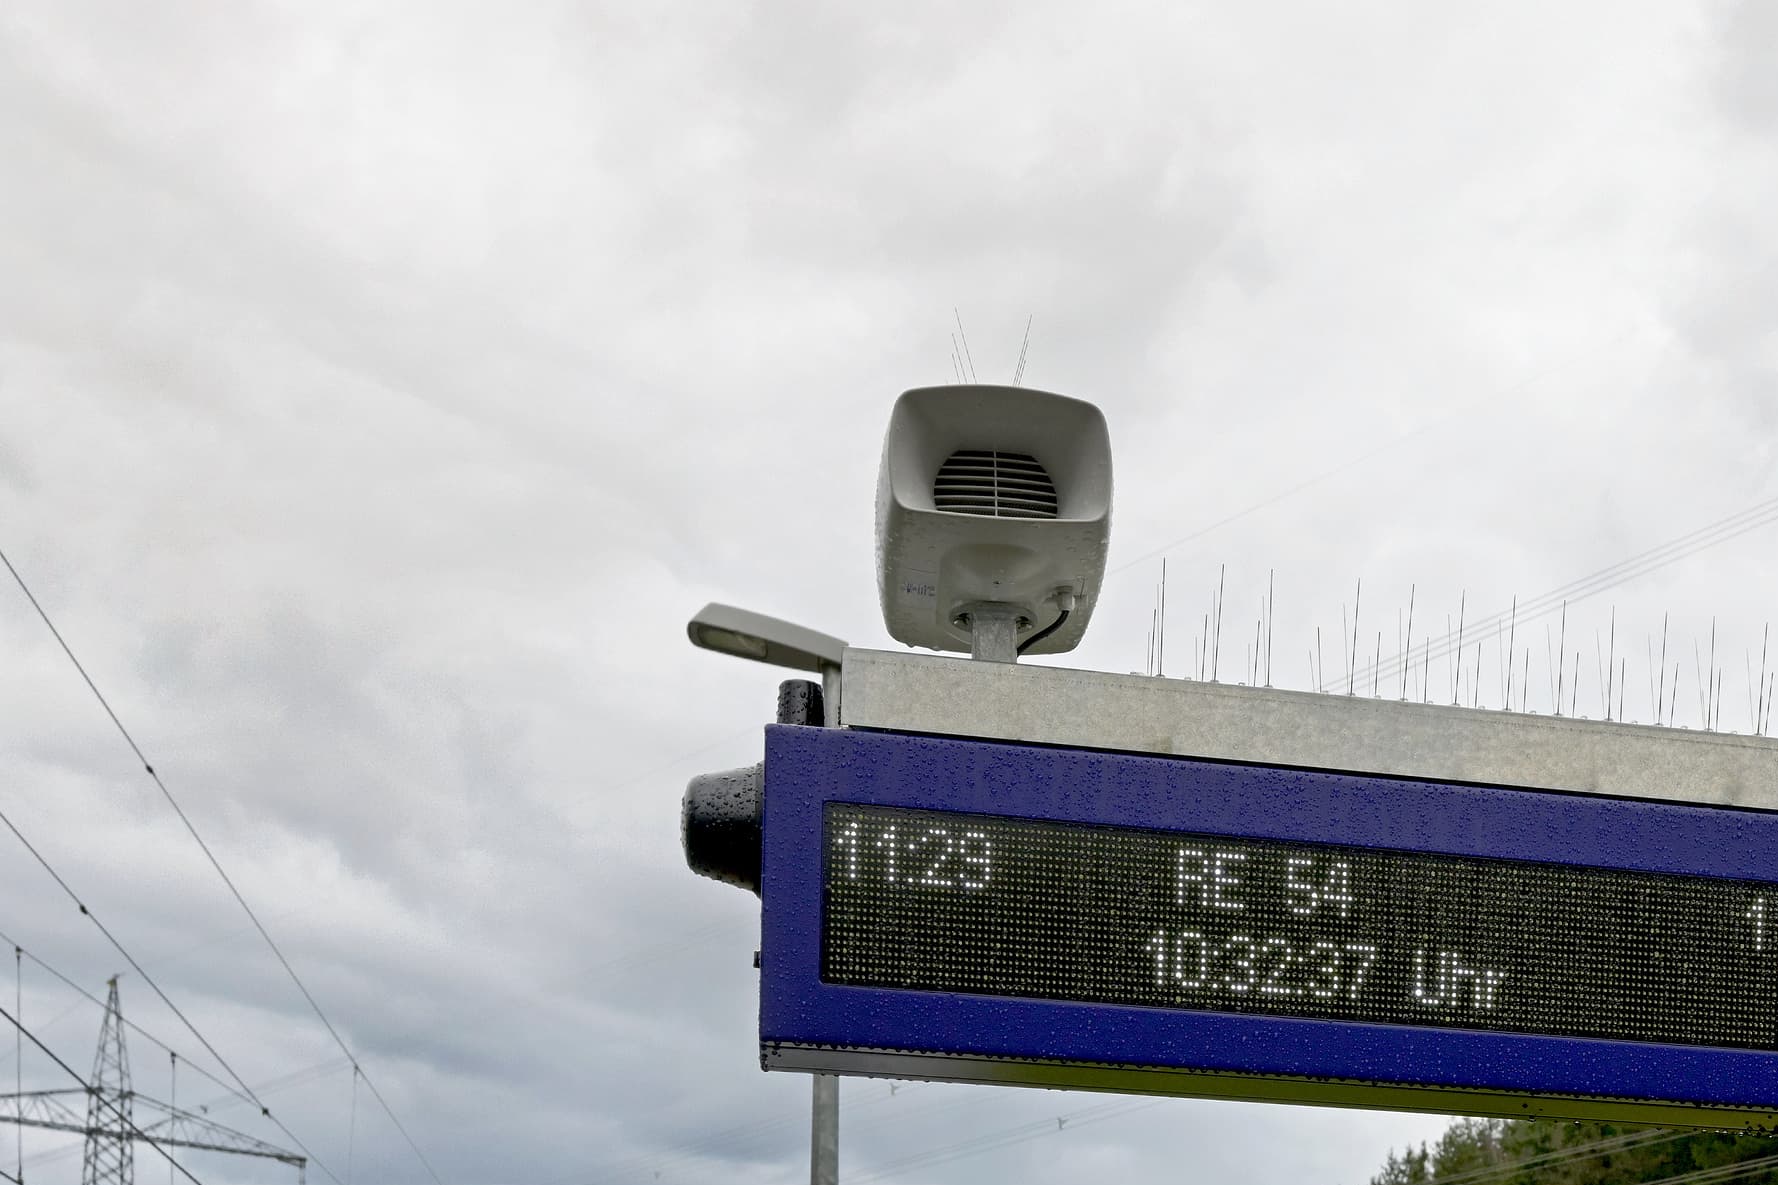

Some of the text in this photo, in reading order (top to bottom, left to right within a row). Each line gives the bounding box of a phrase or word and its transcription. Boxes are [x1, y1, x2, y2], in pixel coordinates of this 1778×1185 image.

[837, 822, 991, 889] 11:29
[1178, 850, 1352, 918] RE 54
[1746, 898, 1764, 950] 1
[1146, 930, 1504, 1008] 10:32:37 Uhr
